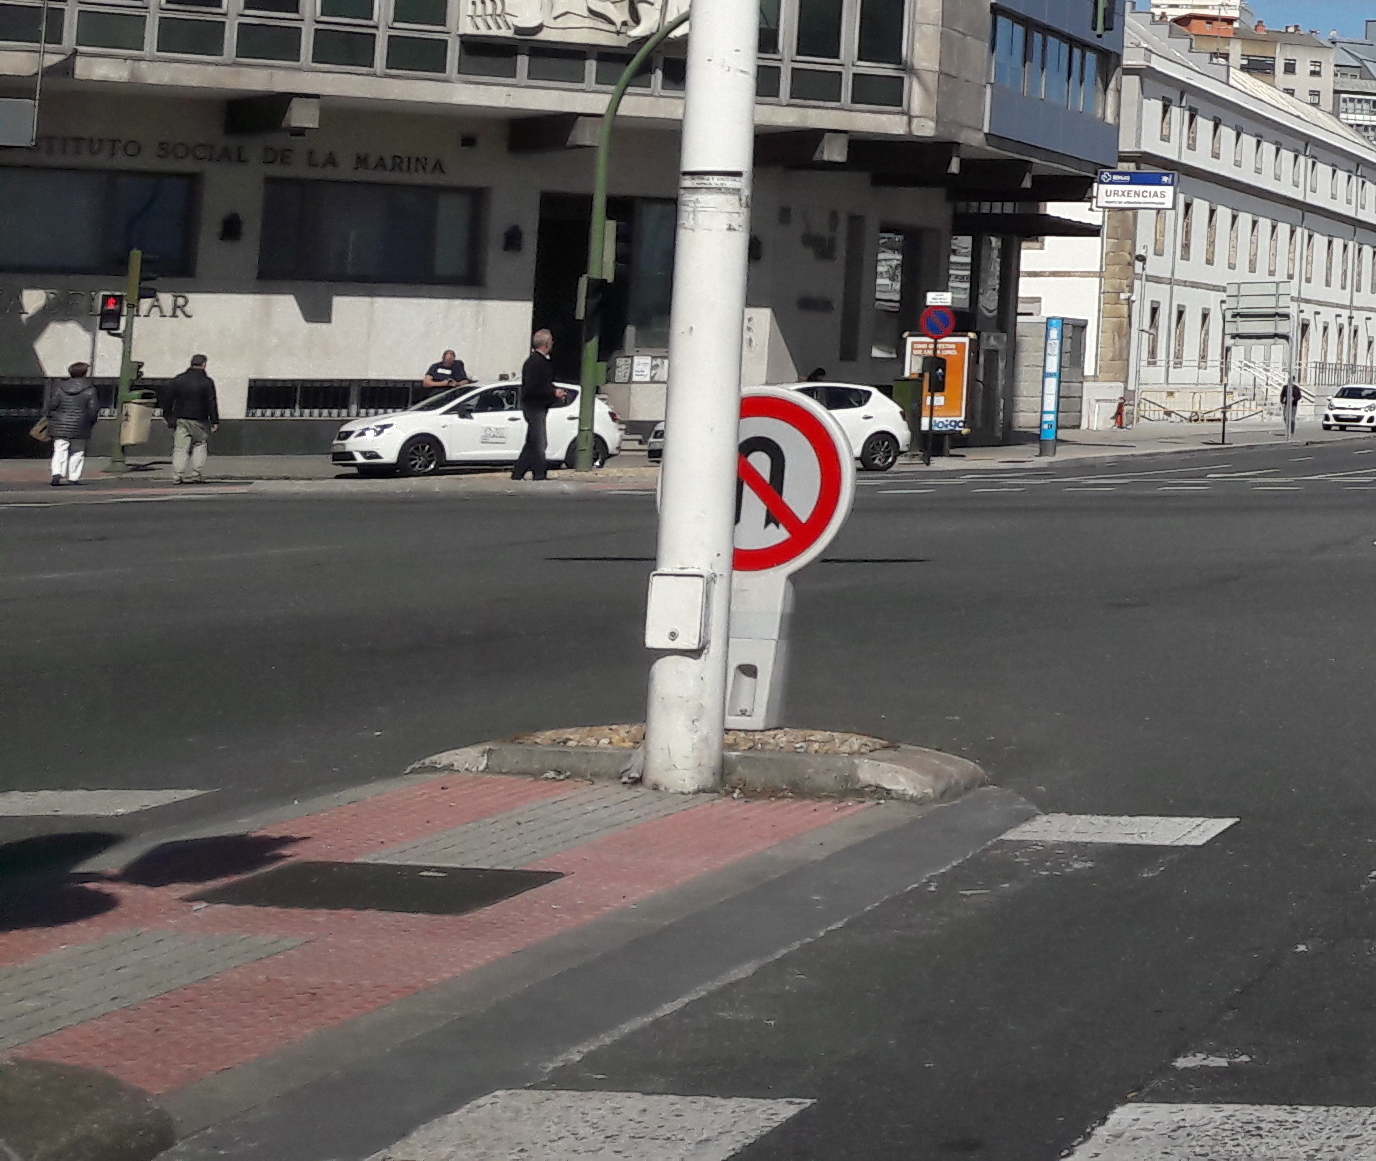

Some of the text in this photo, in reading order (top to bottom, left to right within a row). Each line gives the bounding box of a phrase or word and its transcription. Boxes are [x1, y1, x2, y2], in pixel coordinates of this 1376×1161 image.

[40, 138, 445, 175] TITUTO SOCIAL DE LA MARINA
[1105, 189, 1167, 199] URXENCIAS
